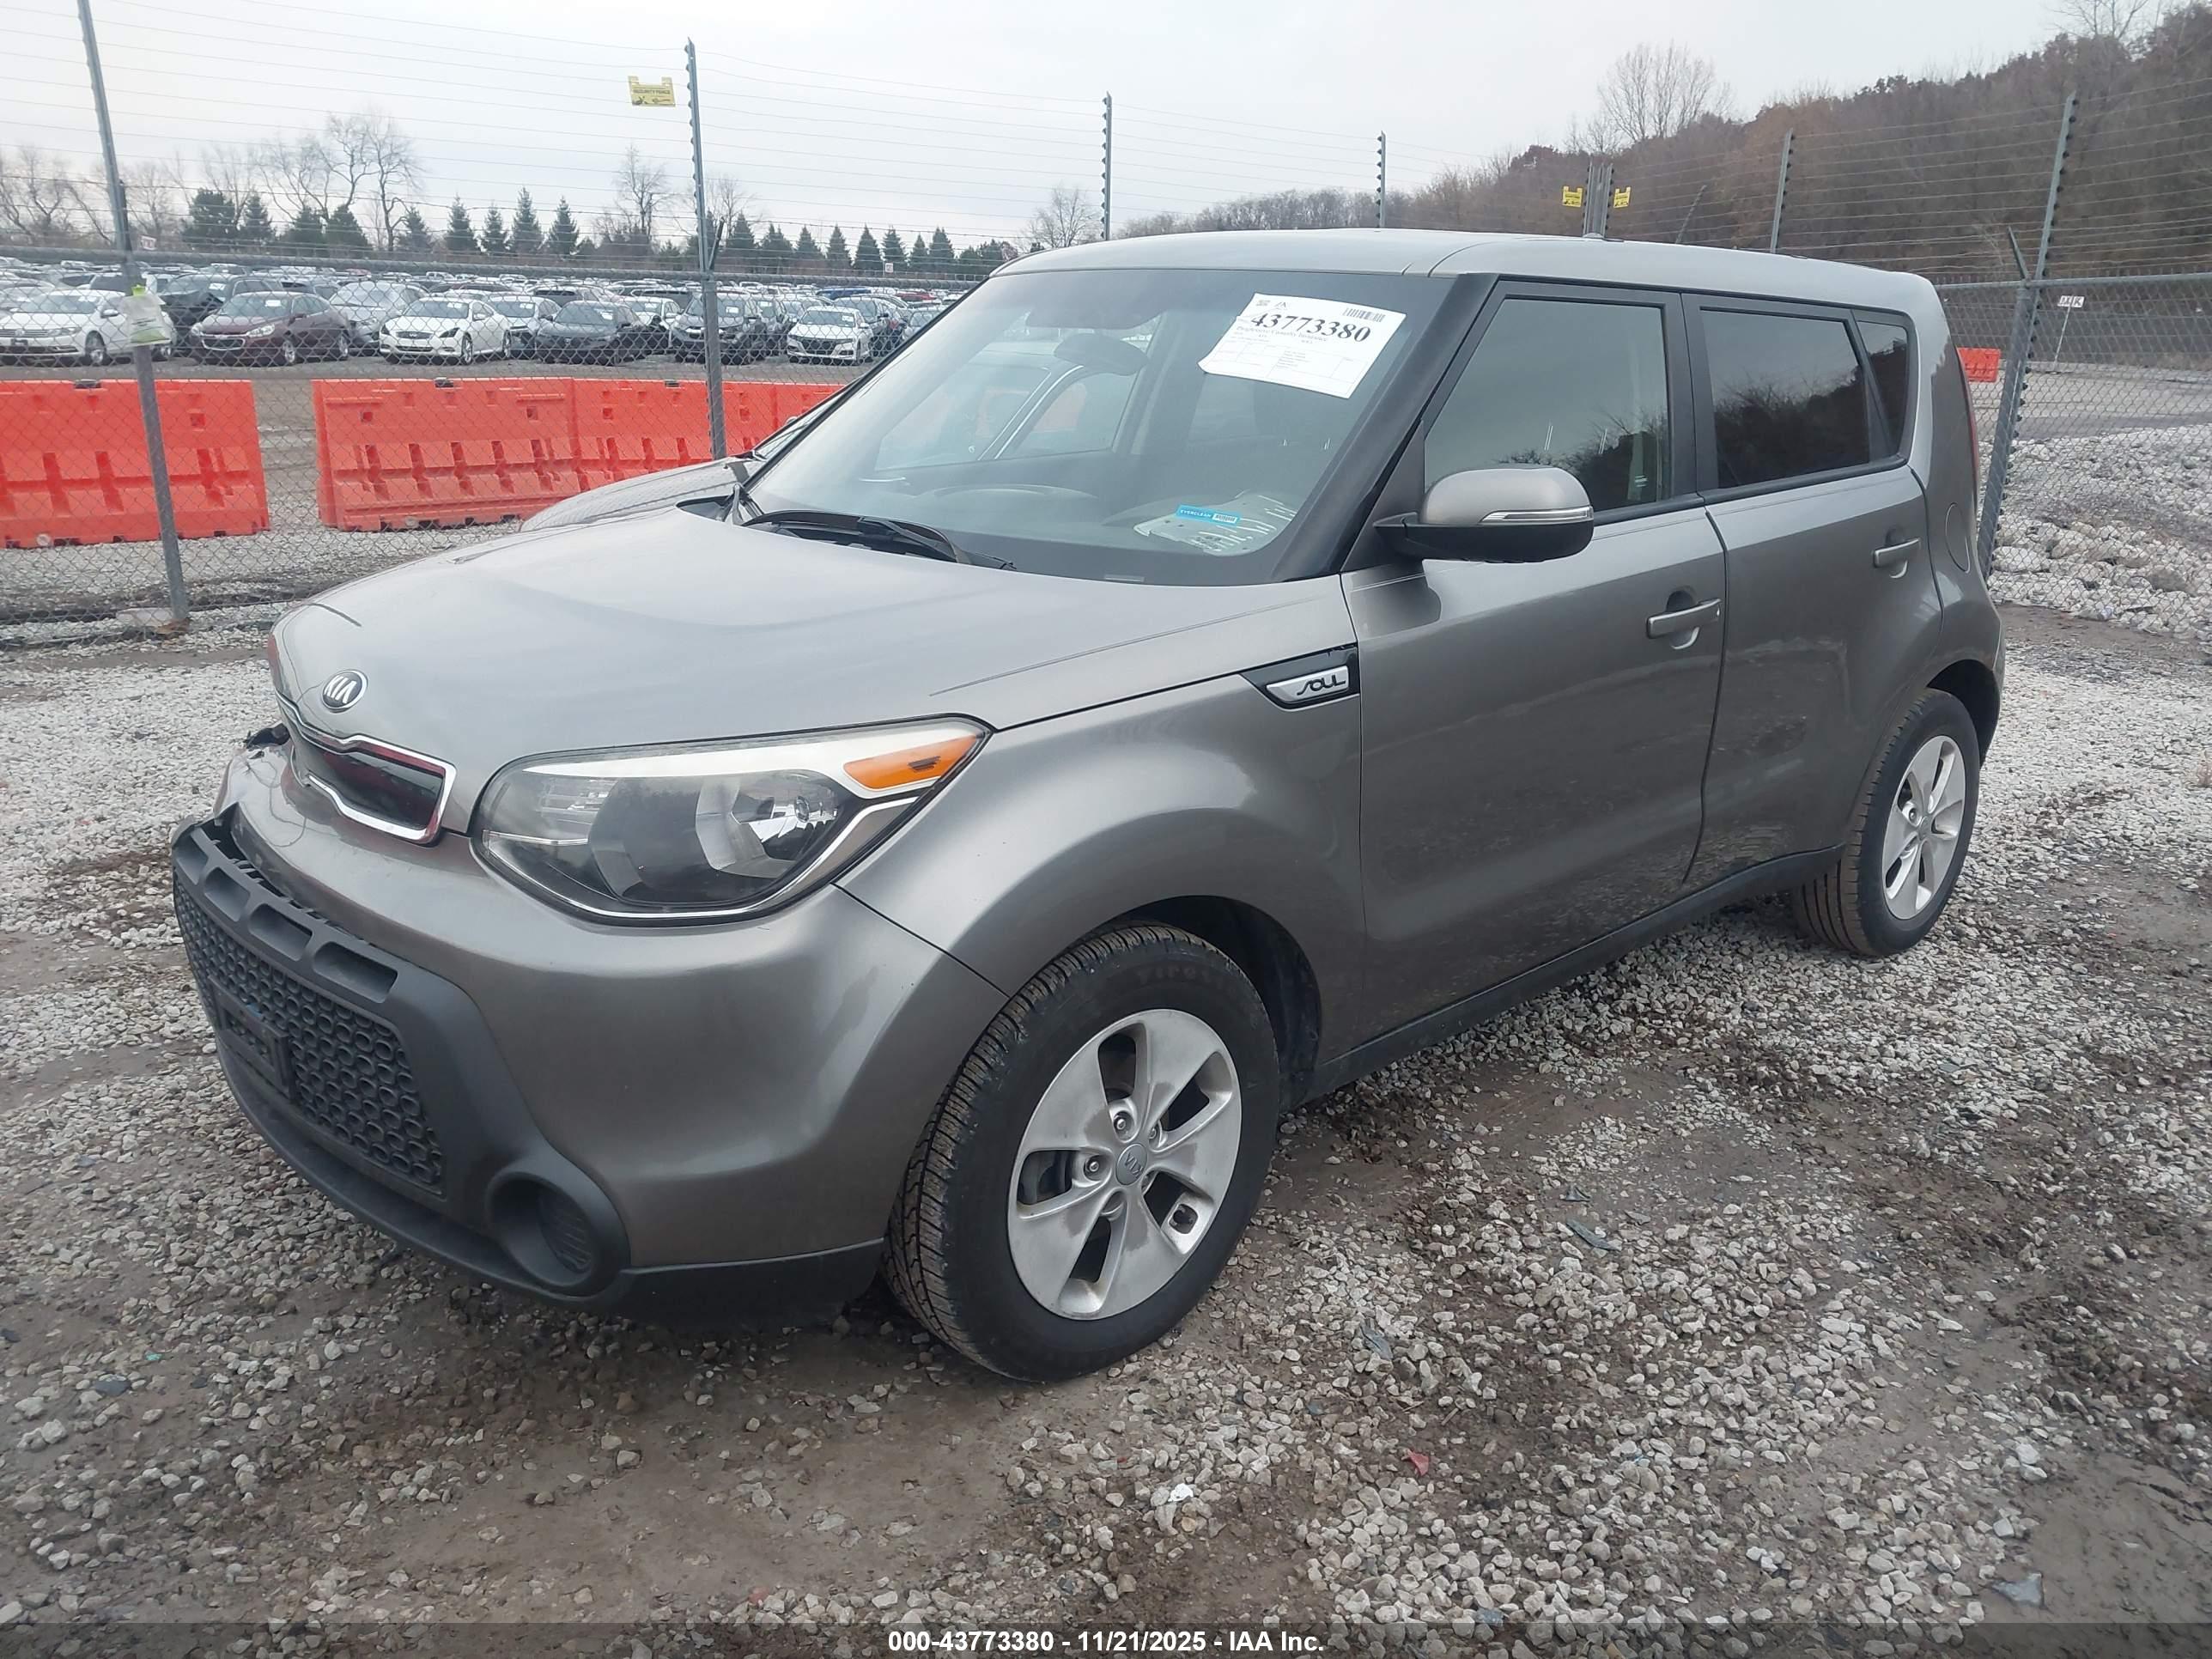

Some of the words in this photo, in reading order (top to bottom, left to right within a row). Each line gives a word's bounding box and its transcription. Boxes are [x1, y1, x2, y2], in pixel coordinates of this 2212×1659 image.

[1250, 312, 1372, 343] 43773380
[325, 675, 358, 704] KIA
[1296, 674, 1346, 696] SOUL
